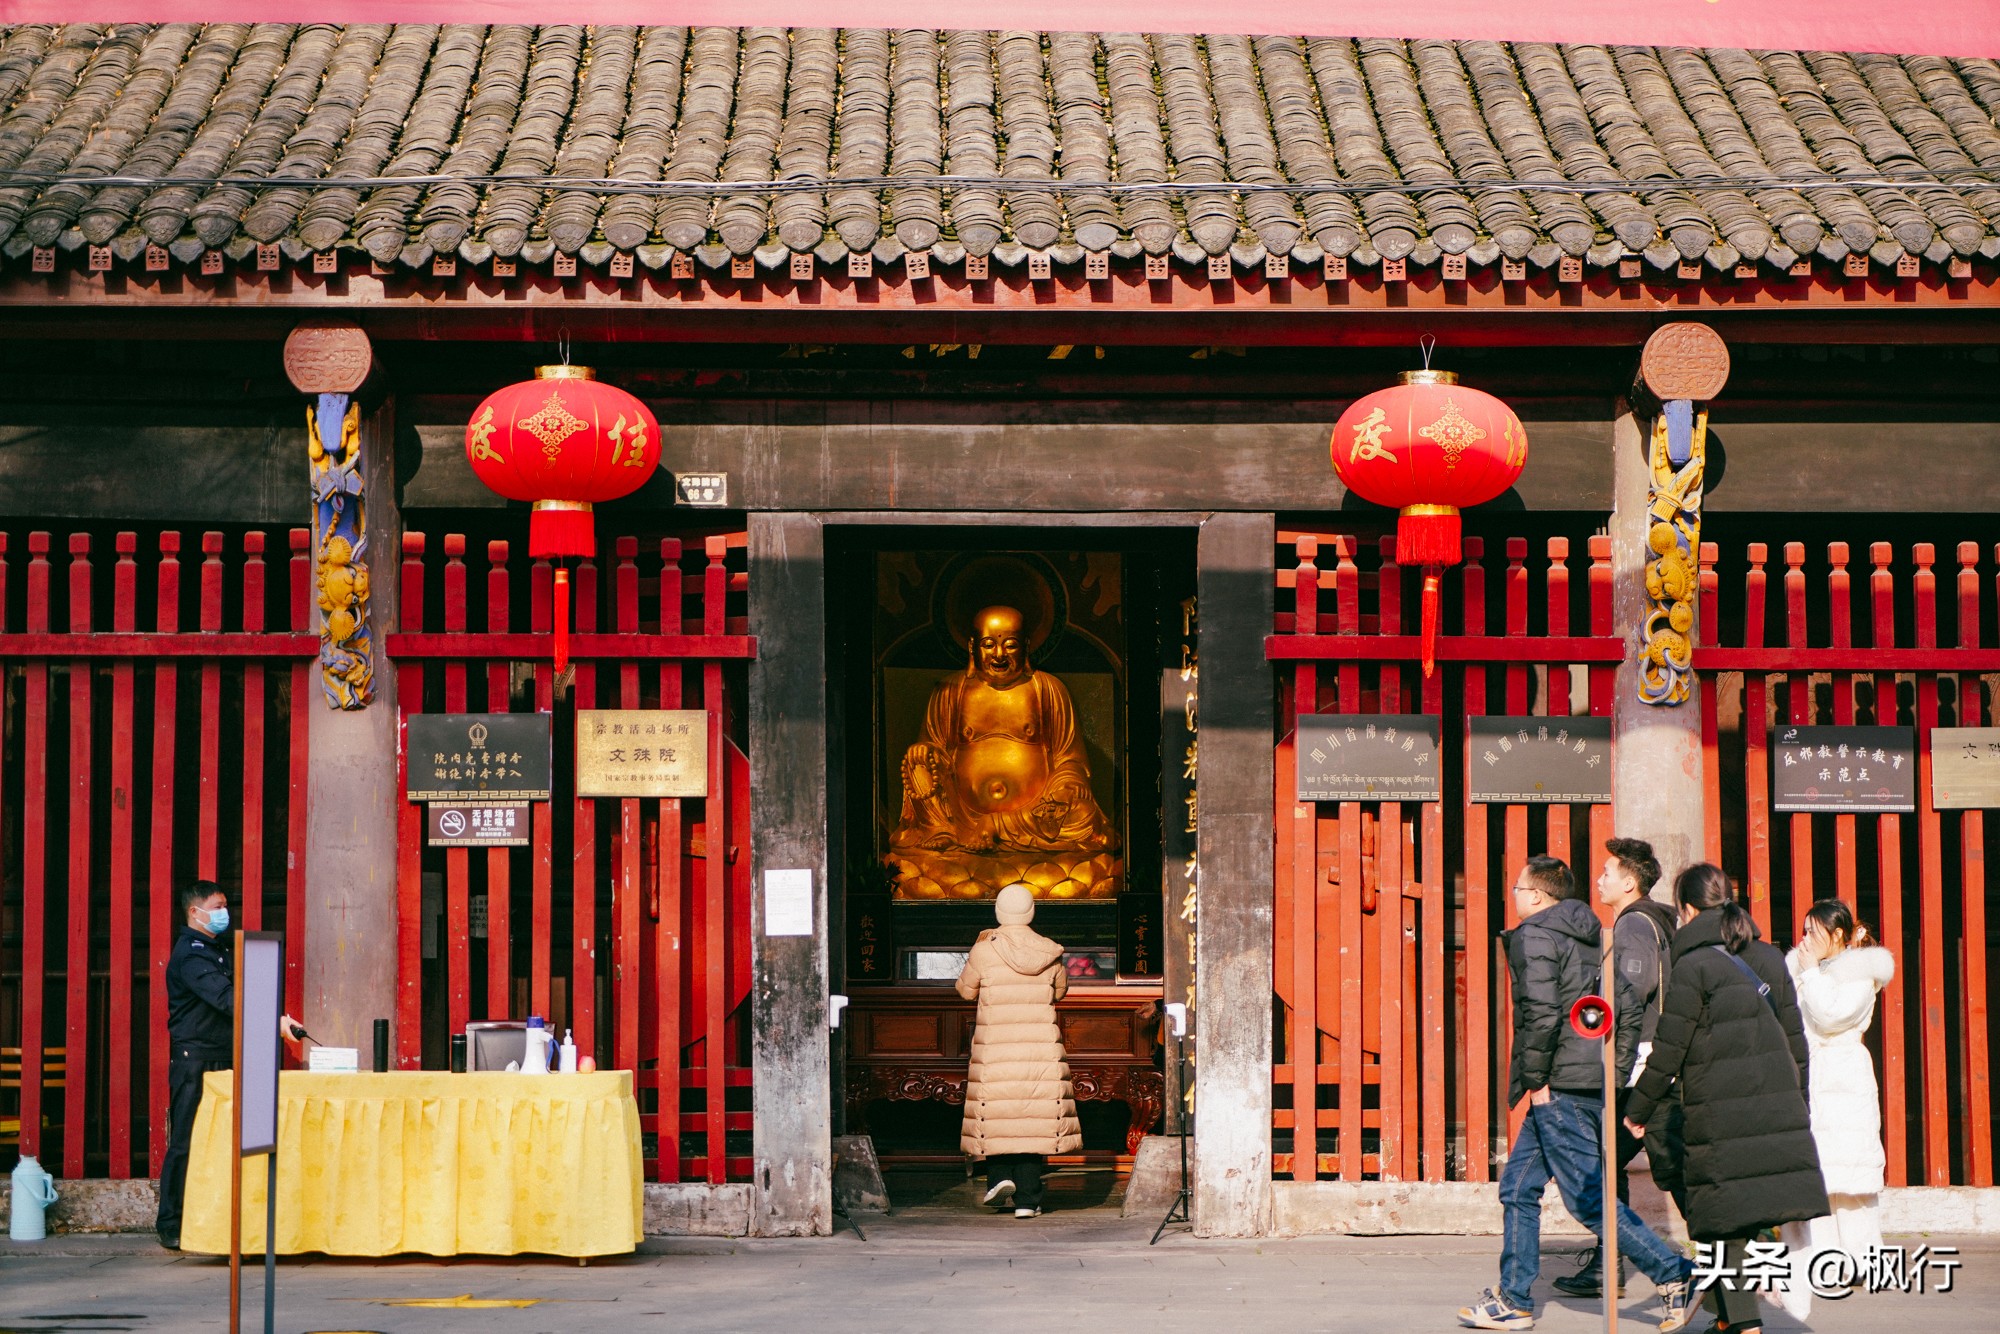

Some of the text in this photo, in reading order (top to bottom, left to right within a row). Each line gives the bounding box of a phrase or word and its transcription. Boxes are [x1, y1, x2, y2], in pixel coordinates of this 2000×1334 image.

[607, 410, 648, 468] 佳
[1350, 407, 1398, 464] 度
[596, 723, 690, 735] 宗教活动场所
[1310, 723, 1429, 767] 四川省佛教协会
[1483, 725, 1601, 768] 成都市佛教协会
[609, 748, 677, 763] 文殊院
[1784, 743, 1905, 770] 反邪教警示教育
[434, 767, 522, 780] 谢绝外香带入
[1818, 767, 1870, 783] 示范点
[472, 809, 515, 818] 无烟场所
[472, 818, 515, 827] 禁止吸烟
